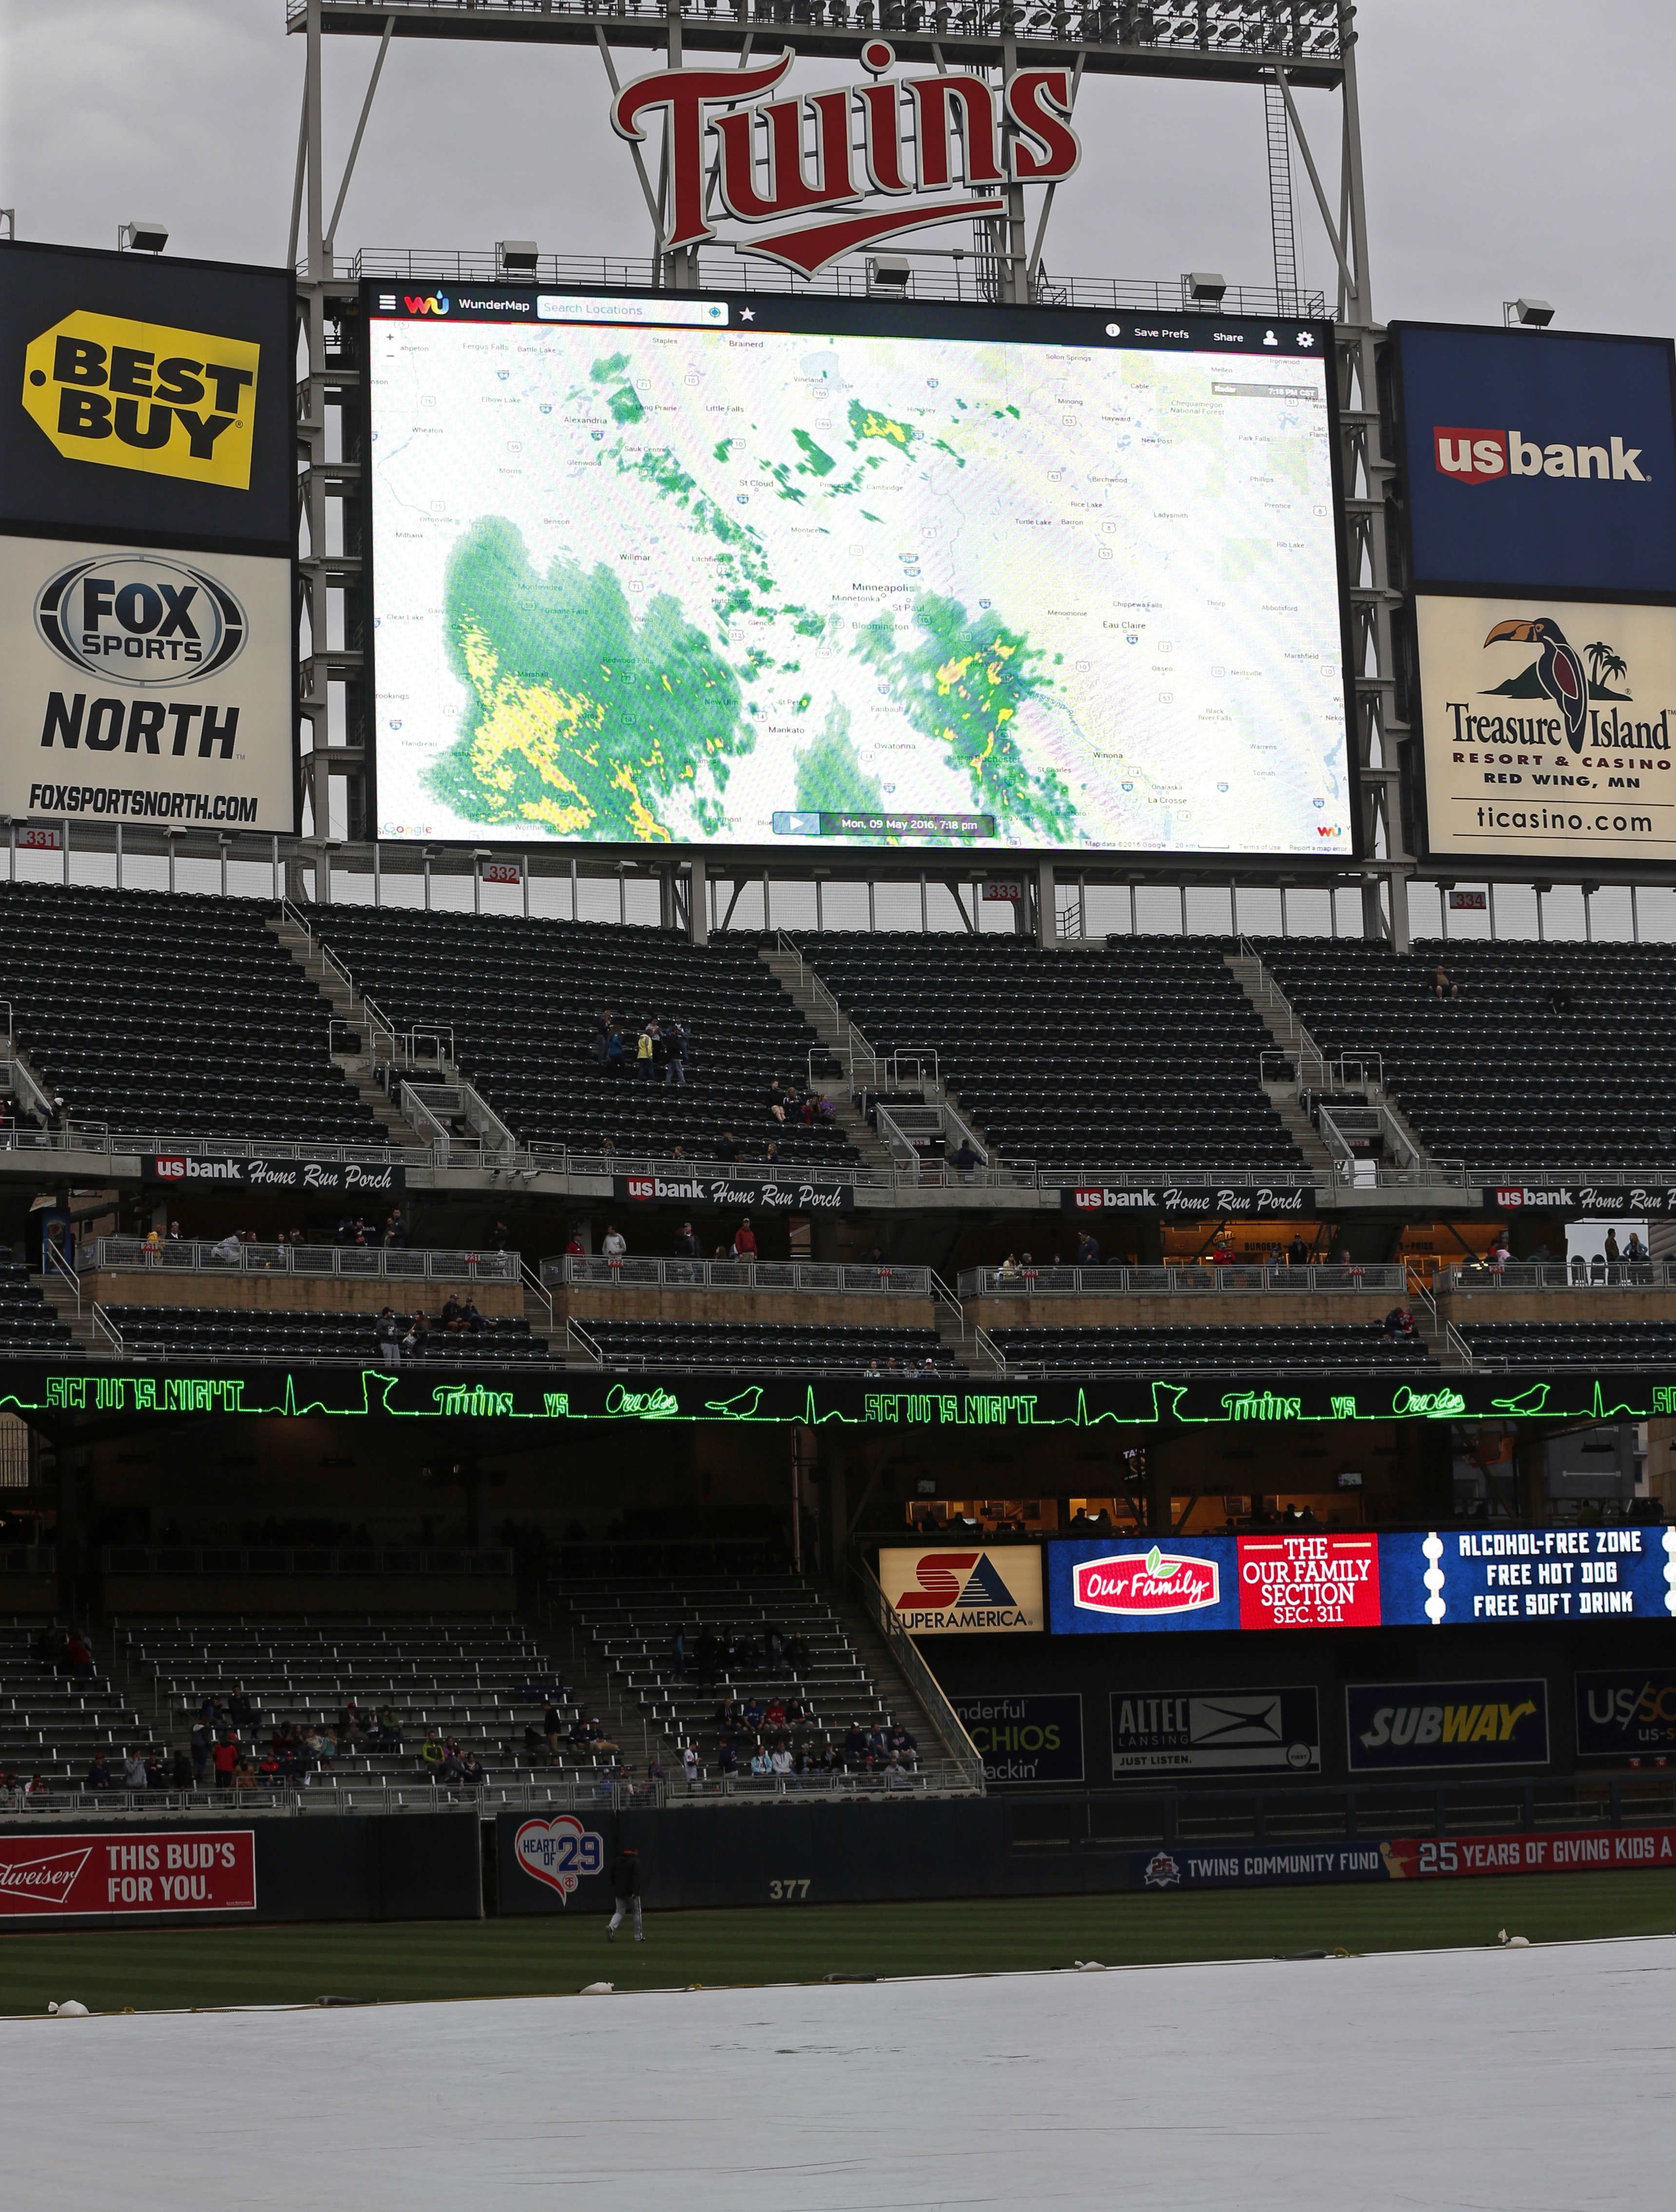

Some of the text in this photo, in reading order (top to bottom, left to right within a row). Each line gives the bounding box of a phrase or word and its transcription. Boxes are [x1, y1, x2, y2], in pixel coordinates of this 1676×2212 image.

[610, 39, 1083, 255] Twins
[459, 299, 529, 312] WunderMap
[544, 303, 582, 313] Search
[586, 305, 643, 316] Locations
[1135, 328, 1159, 337] Save
[1162, 330, 1189, 339] Prefs
[1214, 333, 1244, 342] Share
[53, 335, 253, 414] BEST
[57, 387, 236, 460] BUY
[852, 583, 914, 593] Minneapolis
[83, 577, 200, 639] FOX
[852, 622, 909, 631] Bloomington
[82, 634, 202, 662] SPORTS
[40, 692, 240, 759] NORTH
[1446, 702, 1671, 750] Treasure Island
[1453, 752, 1671, 770] RESORT & CASINO
[1484, 773, 1640, 789] RED WING, MN
[29, 783, 258, 822] FOXSPORTSNORTH.COM
[384, 823, 432, 836] Google
[842, 819, 977, 831] Mon, 09 May 2016, 7:18 pm
[1477, 807, 1652, 832] ticasino.com
[26, 831, 56, 846] 331
[489, 866, 517, 880] 332
[989, 885, 1019, 899] 333
[1456, 893, 1484, 907] 334
[248, 1160, 296, 1185] Home
[303, 1164, 339, 1187] Run
[345, 1165, 391, 1189] Porch
[711, 1181, 755, 1204] Home
[761, 1184, 793, 1207] Run
[799, 1185, 842, 1208] Porch
[1163, 1188, 1210, 1210] Home
[1217, 1190, 1251, 1211] Run
[1257, 1188, 1302, 1212] Porch
[1579, 1188, 1623, 1209] Home
[1630, 1189, 1662, 1210] Run
[433, 1385, 513, 1416] Twins
[606, 1384, 679, 1416] Orioles
[1222, 1390, 1301, 1421] Twins
[1392, 1386, 1465, 1417] Orioles
[1284, 1537, 1328, 1560] THE
[1459, 1531, 1642, 1556] ALCOHOL-FREE ZONE
[1243, 1559, 1371, 1584] OUR FAMILY
[1486, 1561, 1618, 1586] FREE HOT DOG
[1087, 1570, 1210, 1605] Our Family
[1261, 1582, 1355, 1606] SECTION
[1273, 1606, 1344, 1624] SEC. 311
[1473, 1591, 1633, 1617] FREE SOFT DRINK
[891, 1610, 1026, 1630] SUPERAMERICA
[1119, 1698, 1188, 1734] ALTEC
[1361, 1700, 1536, 1748] SUBWAY
[1118, 1735, 1189, 1746] LANSING
[1119, 1755, 1193, 1766] JUST LISTEN.
[106, 1843, 236, 1871] THIS BUD'S
[523, 1833, 603, 1874] HEART 29
[543, 1853, 555, 1866] OF
[1188, 1852, 1379, 1877] TWINS COMMUNITY FUND
[1419, 1836, 1673, 1873] 25 YEARS OF GIVING KIDS A
[108, 1875, 213, 1903] FOR YOU.
[770, 1879, 811, 1900] 377
